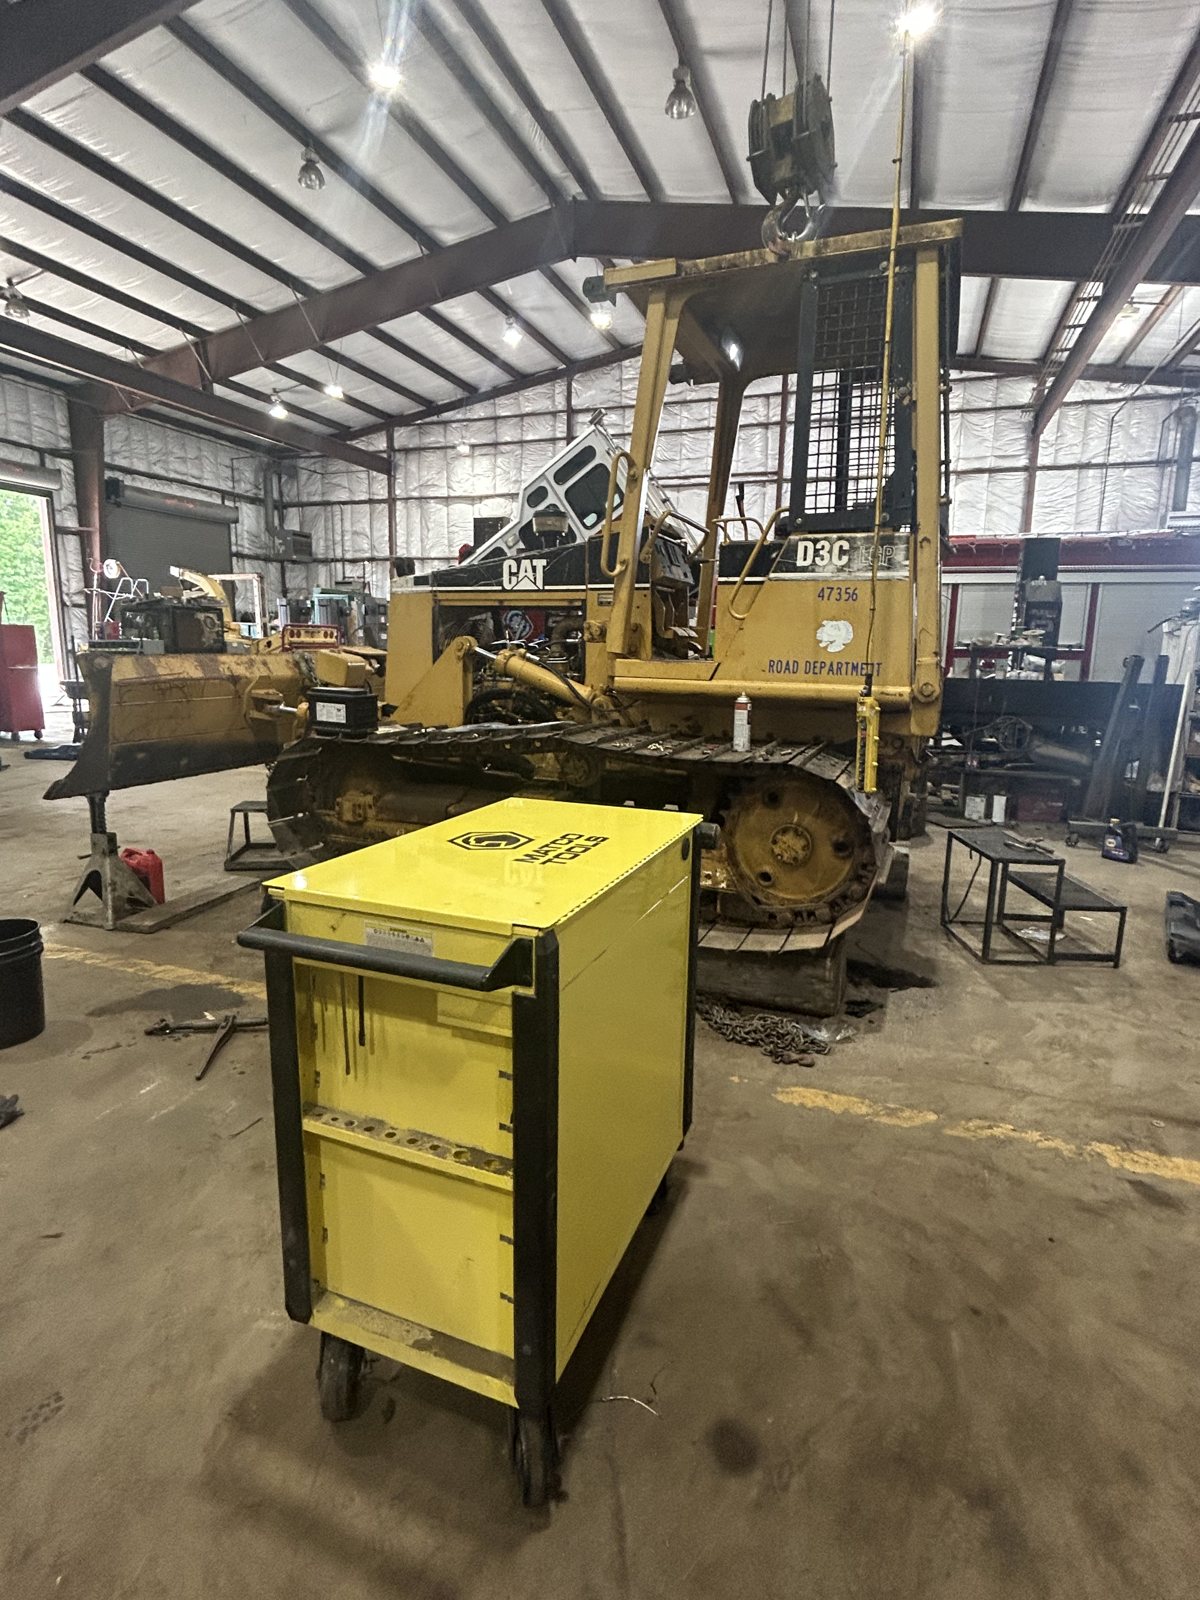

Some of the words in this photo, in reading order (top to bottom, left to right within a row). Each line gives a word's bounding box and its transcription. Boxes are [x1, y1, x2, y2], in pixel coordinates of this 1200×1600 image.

[796, 540, 850, 567] D3C
[503, 558, 547, 590] CAT
[817, 586, 858, 602] 47356
[768, 659, 799, 674] ROAD
[513, 833, 584, 864] MATCO
[539, 835, 610, 865] TOOLS
